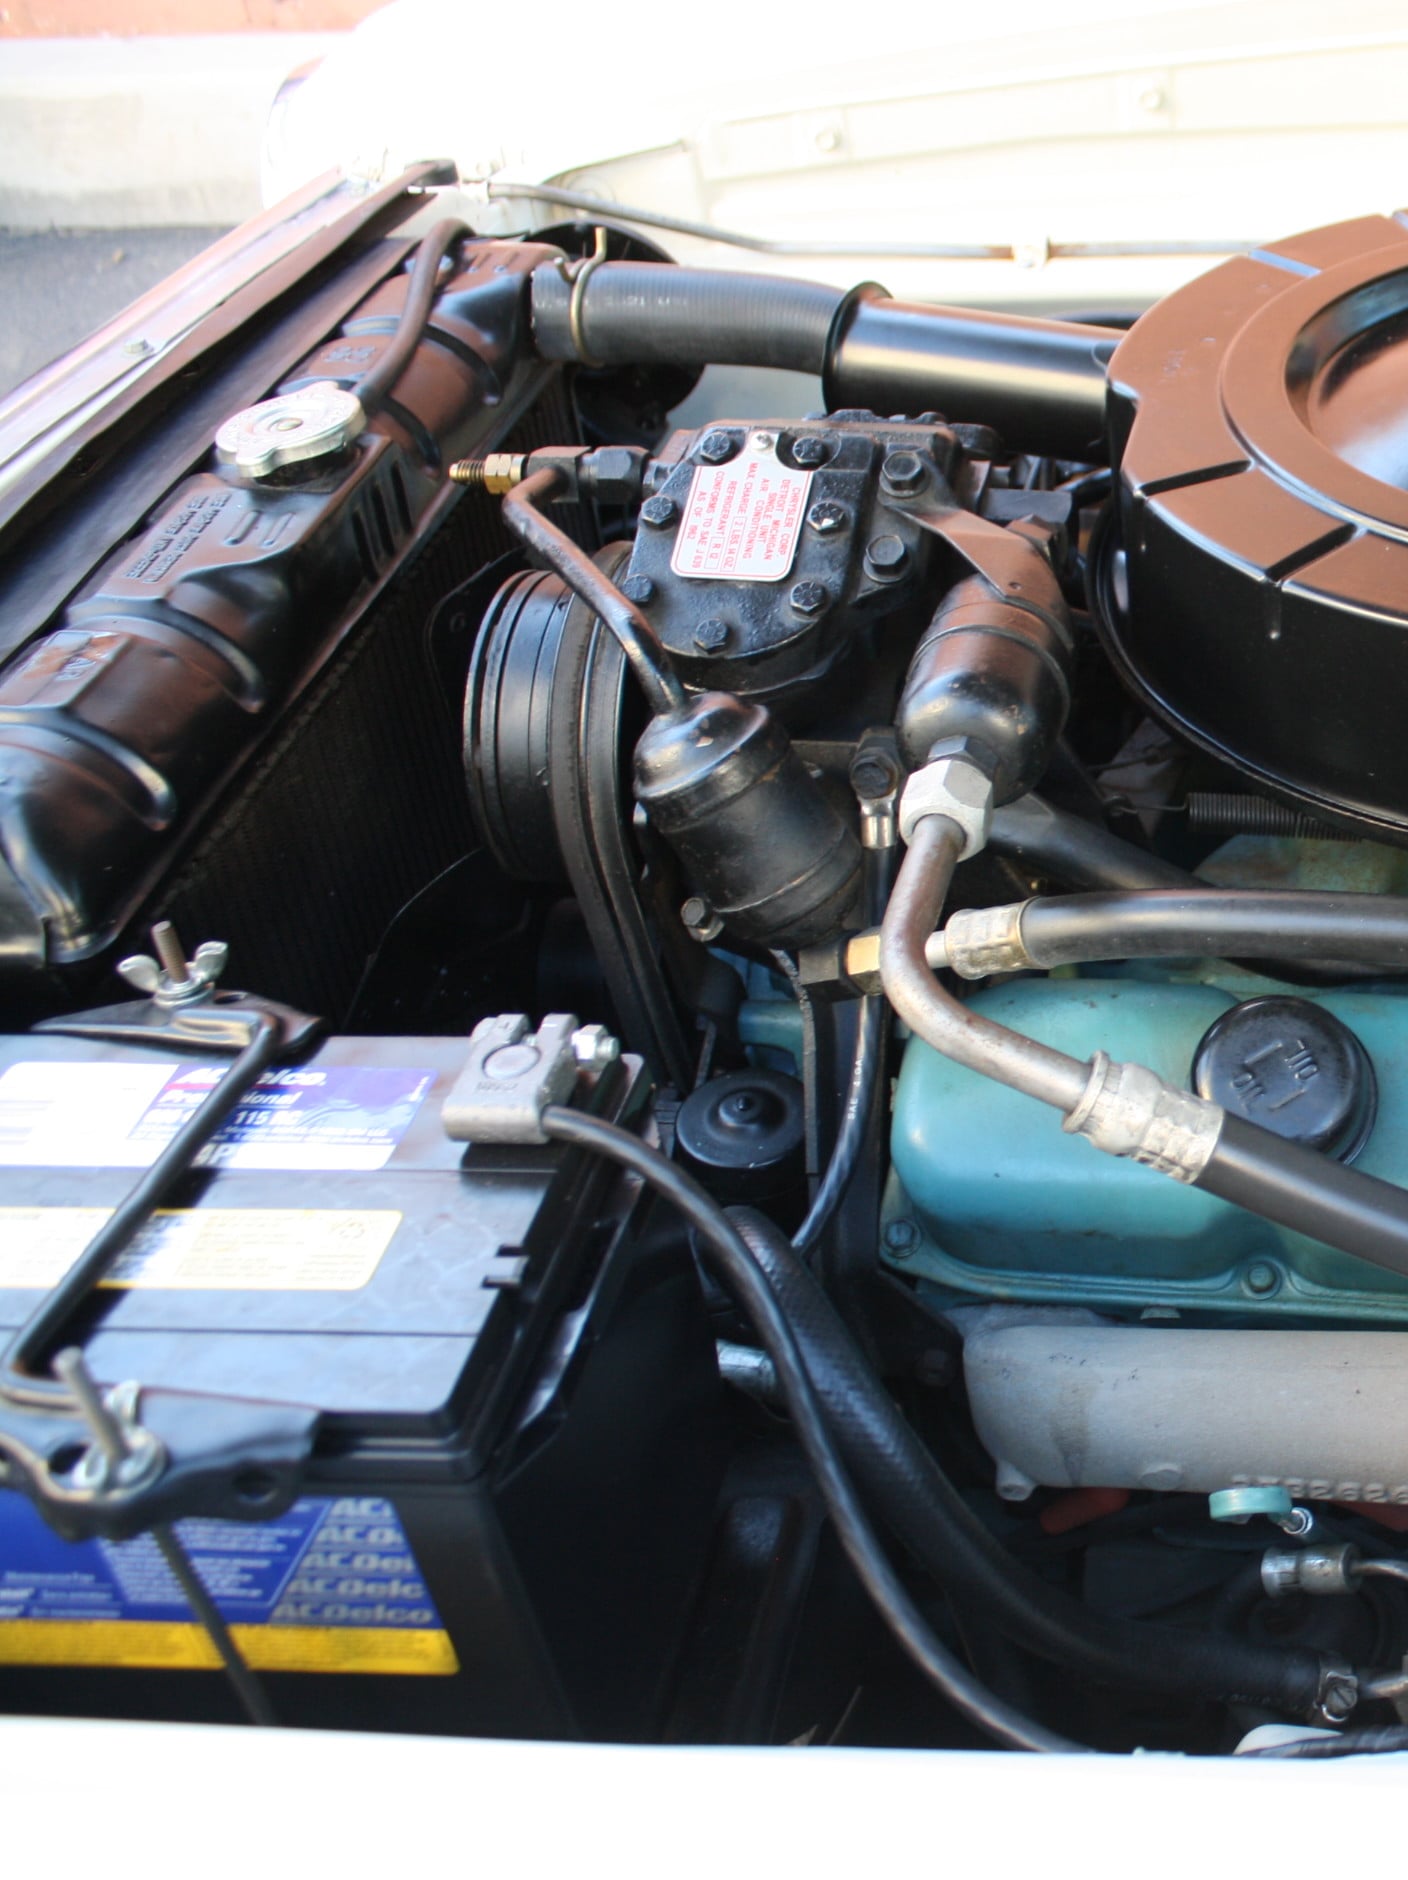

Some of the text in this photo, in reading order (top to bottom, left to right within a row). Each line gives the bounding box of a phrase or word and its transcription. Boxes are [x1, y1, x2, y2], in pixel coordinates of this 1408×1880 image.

[697, 491, 706, 502] AS
[706, 471, 724, 513] CONFORMS
[737, 482, 752, 514] CHARGE
[693, 507, 702, 518] OF
[716, 480, 736, 535] REFRIGERANT
[742, 478, 769, 559] AIR CONDITIONING
[757, 492, 776, 543] SINGLE UNIT
[763, 479, 790, 560] DETROIT MICHIGAN
[783, 487, 800, 527] CHRYSLER
[702, 517, 711, 527] TO
[698, 531, 708, 546] SAE
[175, 1069, 326, 1086] ACelco
[234, 1111, 267, 1125] 115
[272, 1604, 434, 1623] ACDelco
